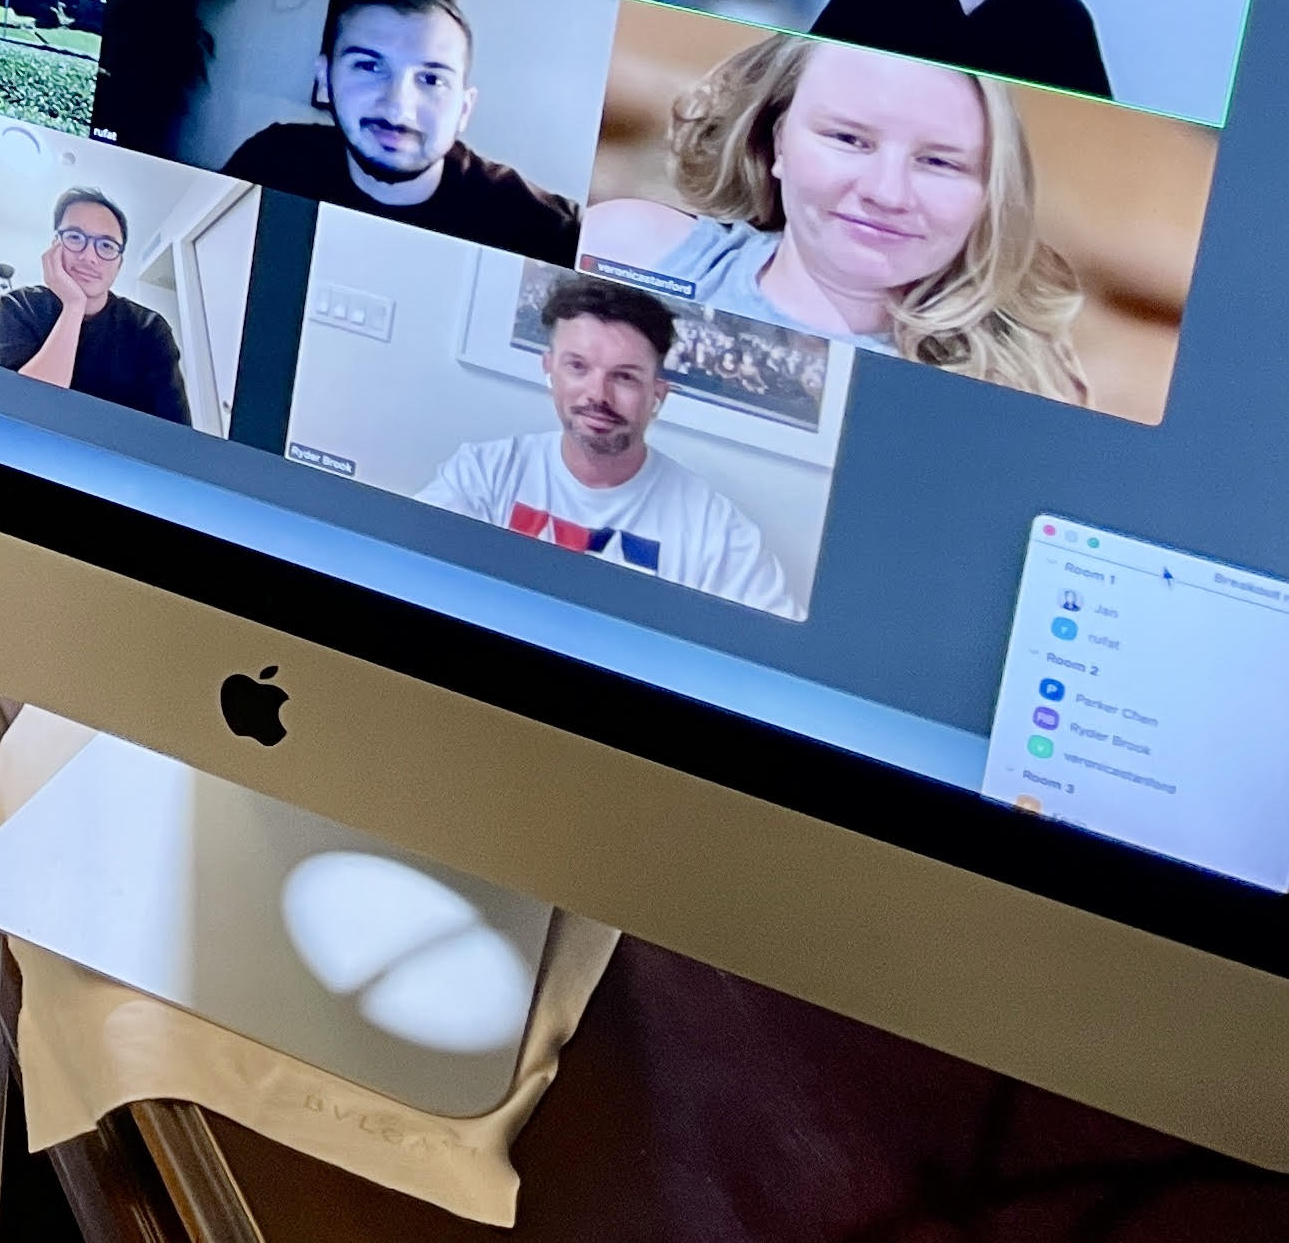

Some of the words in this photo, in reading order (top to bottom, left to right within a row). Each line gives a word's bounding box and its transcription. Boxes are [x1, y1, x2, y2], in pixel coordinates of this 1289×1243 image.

[1064, 561, 1105, 582] Room
[1046, 651, 1086, 673] Room
[1069, 722, 1110, 742] Ryder
[1023, 769, 1062, 790] Room
